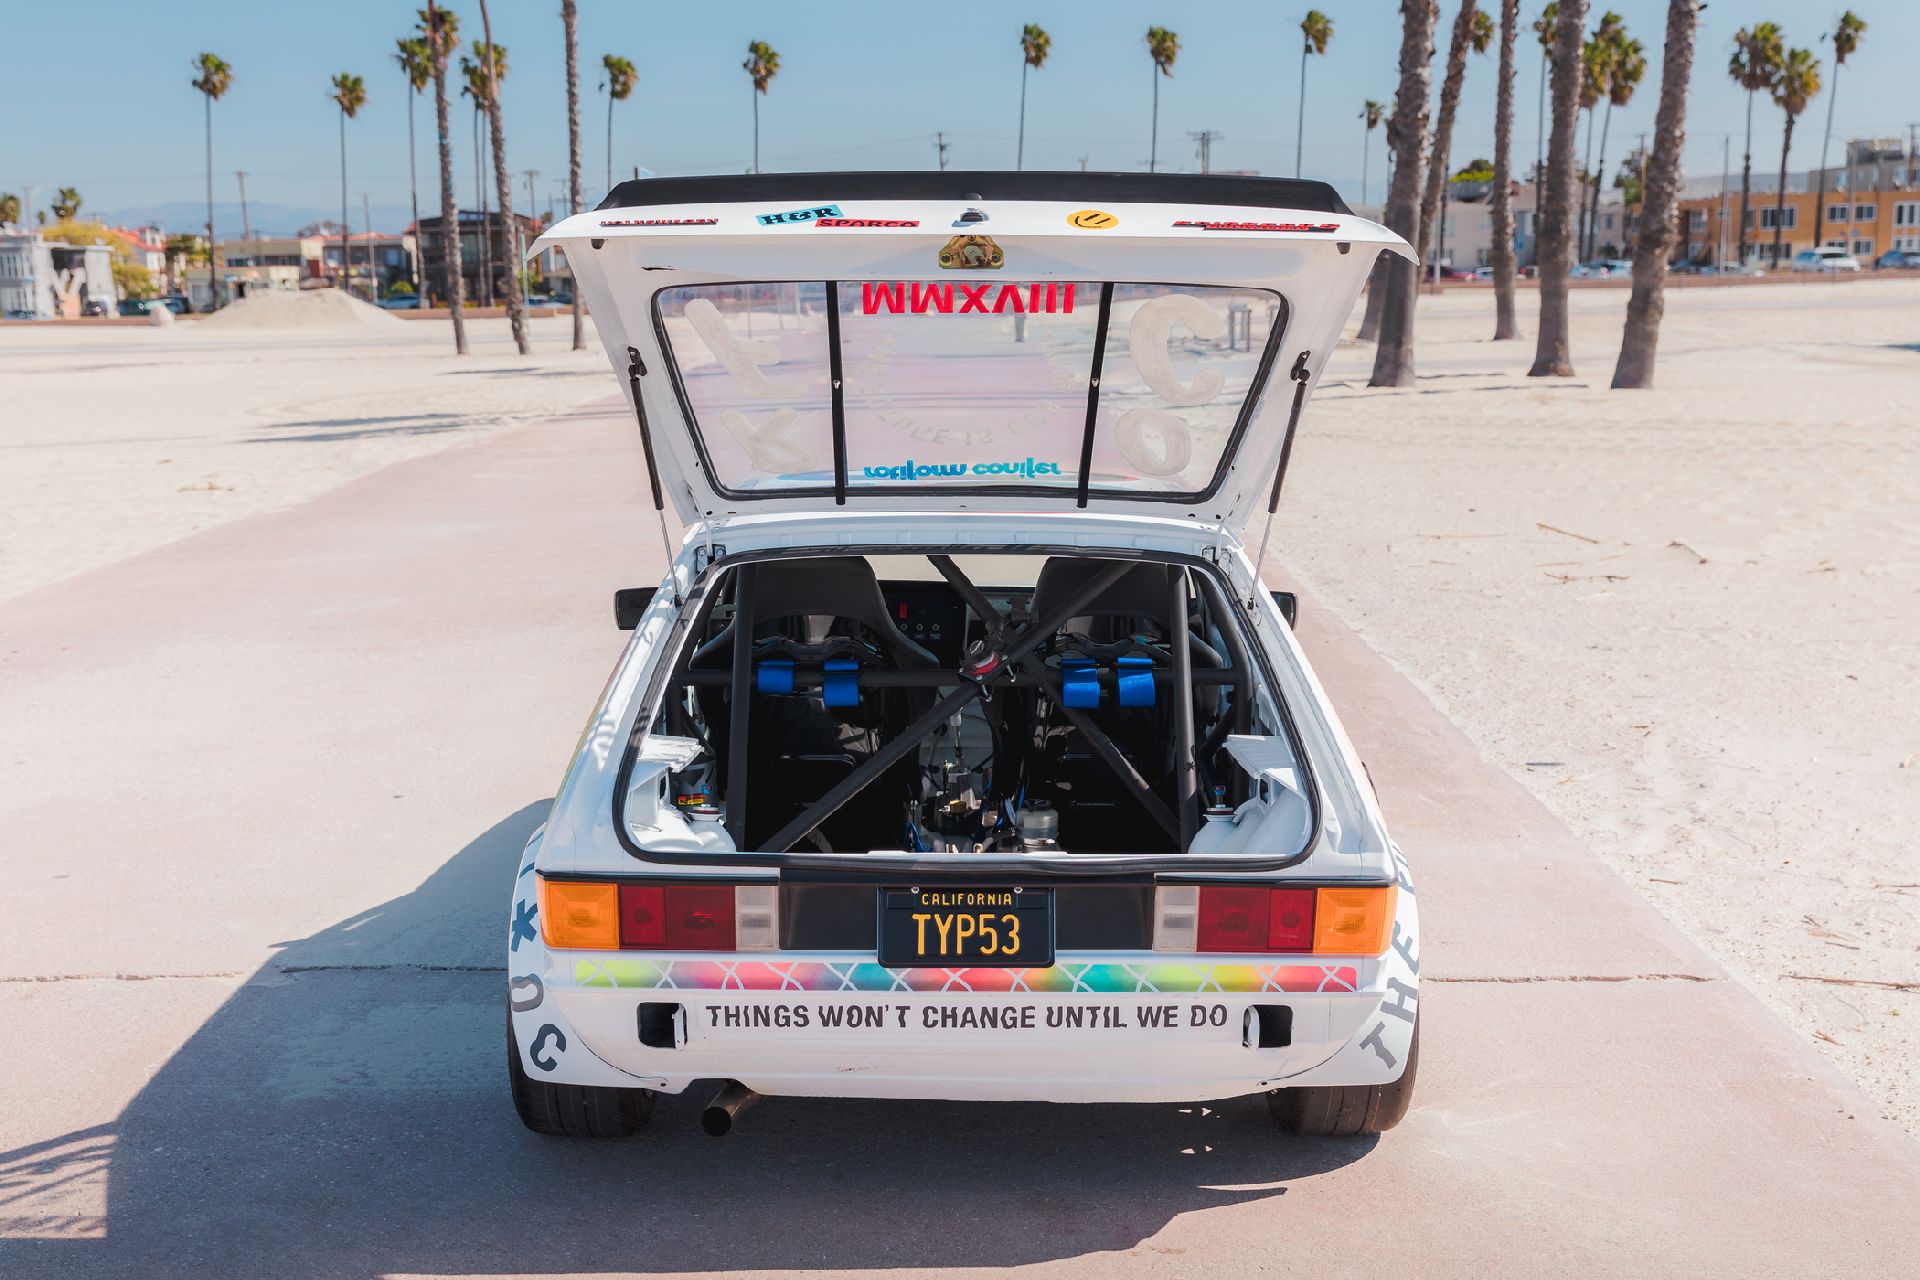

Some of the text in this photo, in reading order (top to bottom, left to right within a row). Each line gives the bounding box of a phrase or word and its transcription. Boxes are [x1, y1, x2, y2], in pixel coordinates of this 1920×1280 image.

[761, 207, 838, 225] H&R
[819, 219, 917, 228] SPARCO
[921, 893, 1012, 906] CALIFORNIA
[912, 914, 1020, 955] TYP53
[706, 1004, 1228, 1030] THINGS WON'T CHANGE UNTIL WE DO
